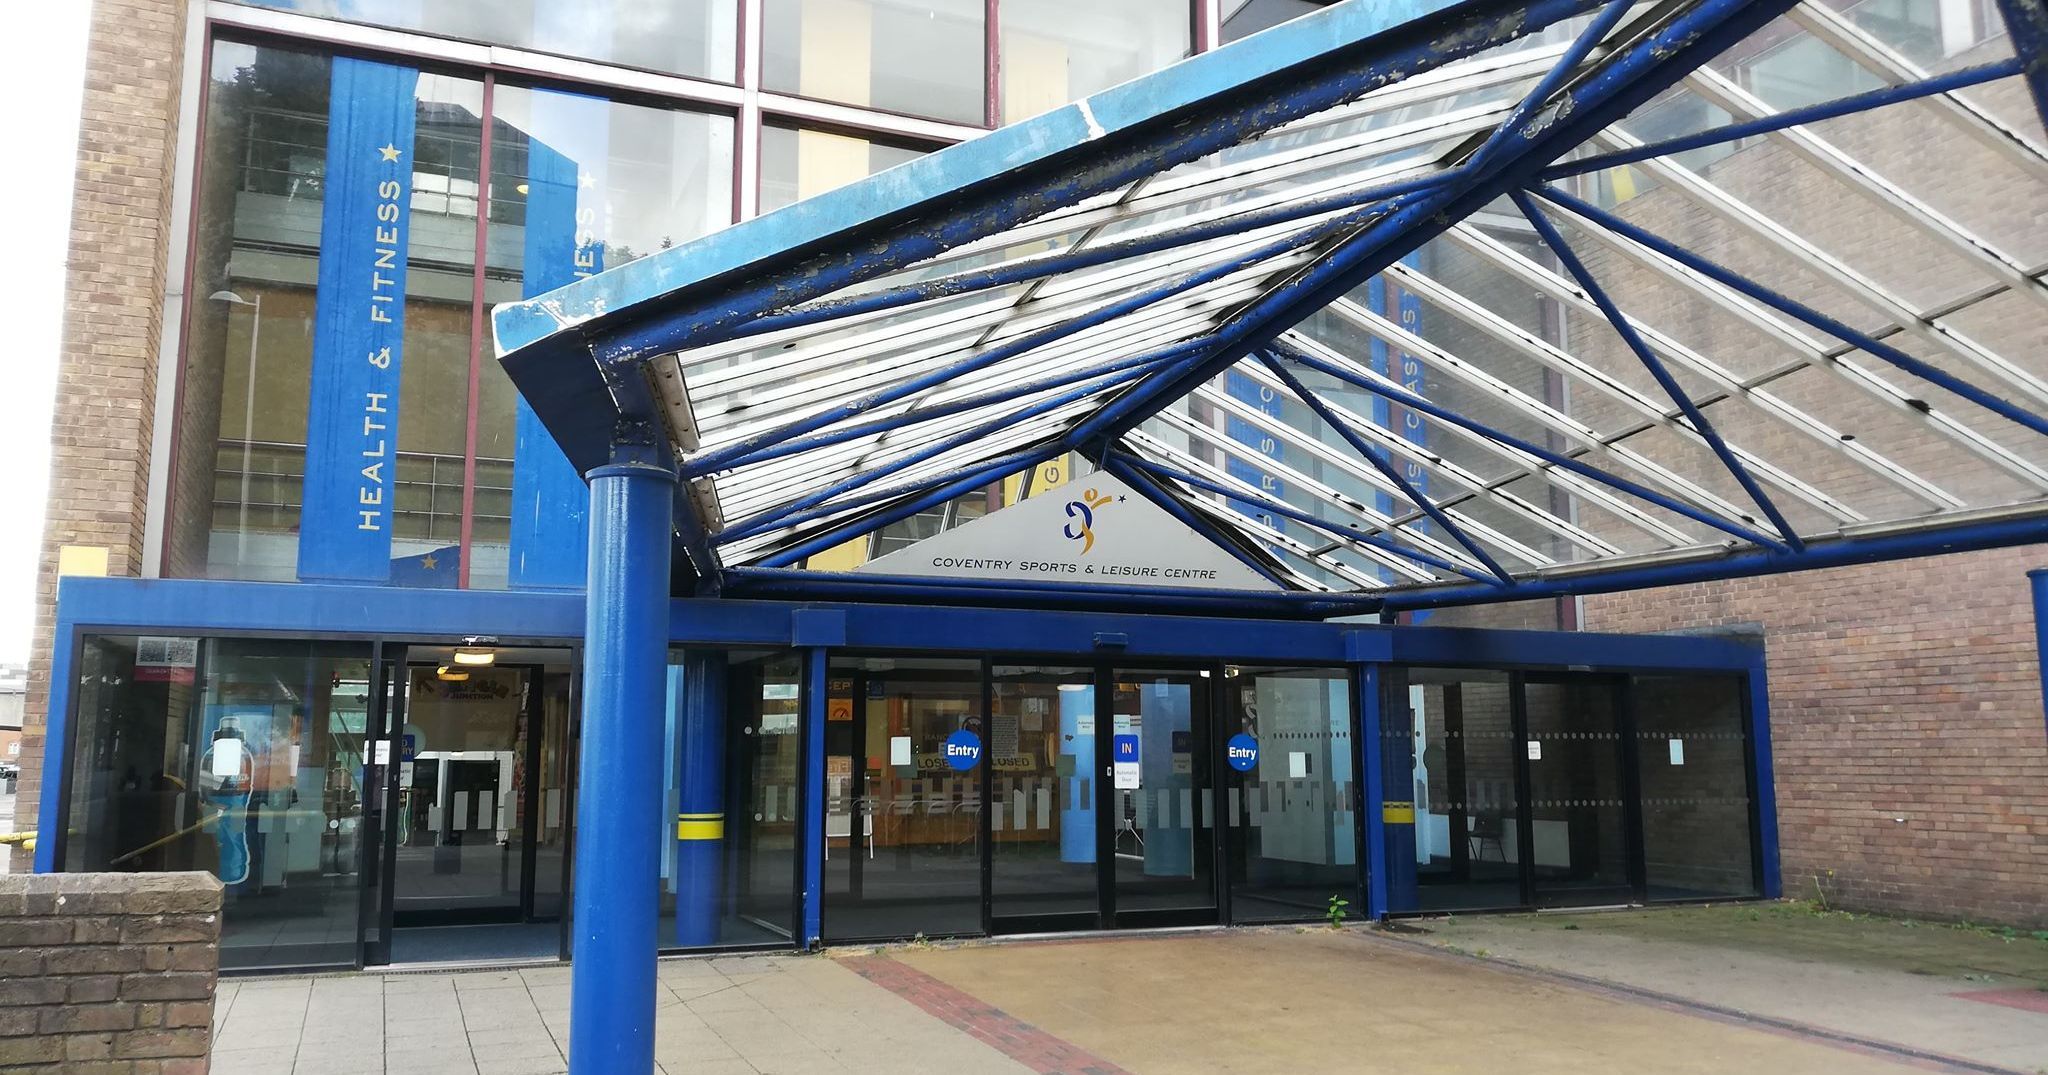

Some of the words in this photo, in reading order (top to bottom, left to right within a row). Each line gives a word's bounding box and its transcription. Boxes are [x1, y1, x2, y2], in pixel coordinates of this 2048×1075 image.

[371, 180, 401, 323] FITNESS
[369, 346, 391, 369] &
[358, 392, 388, 531] HEALTH
[932, 557, 1013, 571] COVENTRY
[1019, 561, 1077, 573] SPORTS
[1084, 564, 1095, 574] &
[1101, 565, 1159, 577] LEISURE
[1164, 568, 1217, 580] CENTRE
[947, 744, 979, 758] Entry
[1121, 743, 1132, 754] IN
[1229, 747, 1256, 760] Entry
